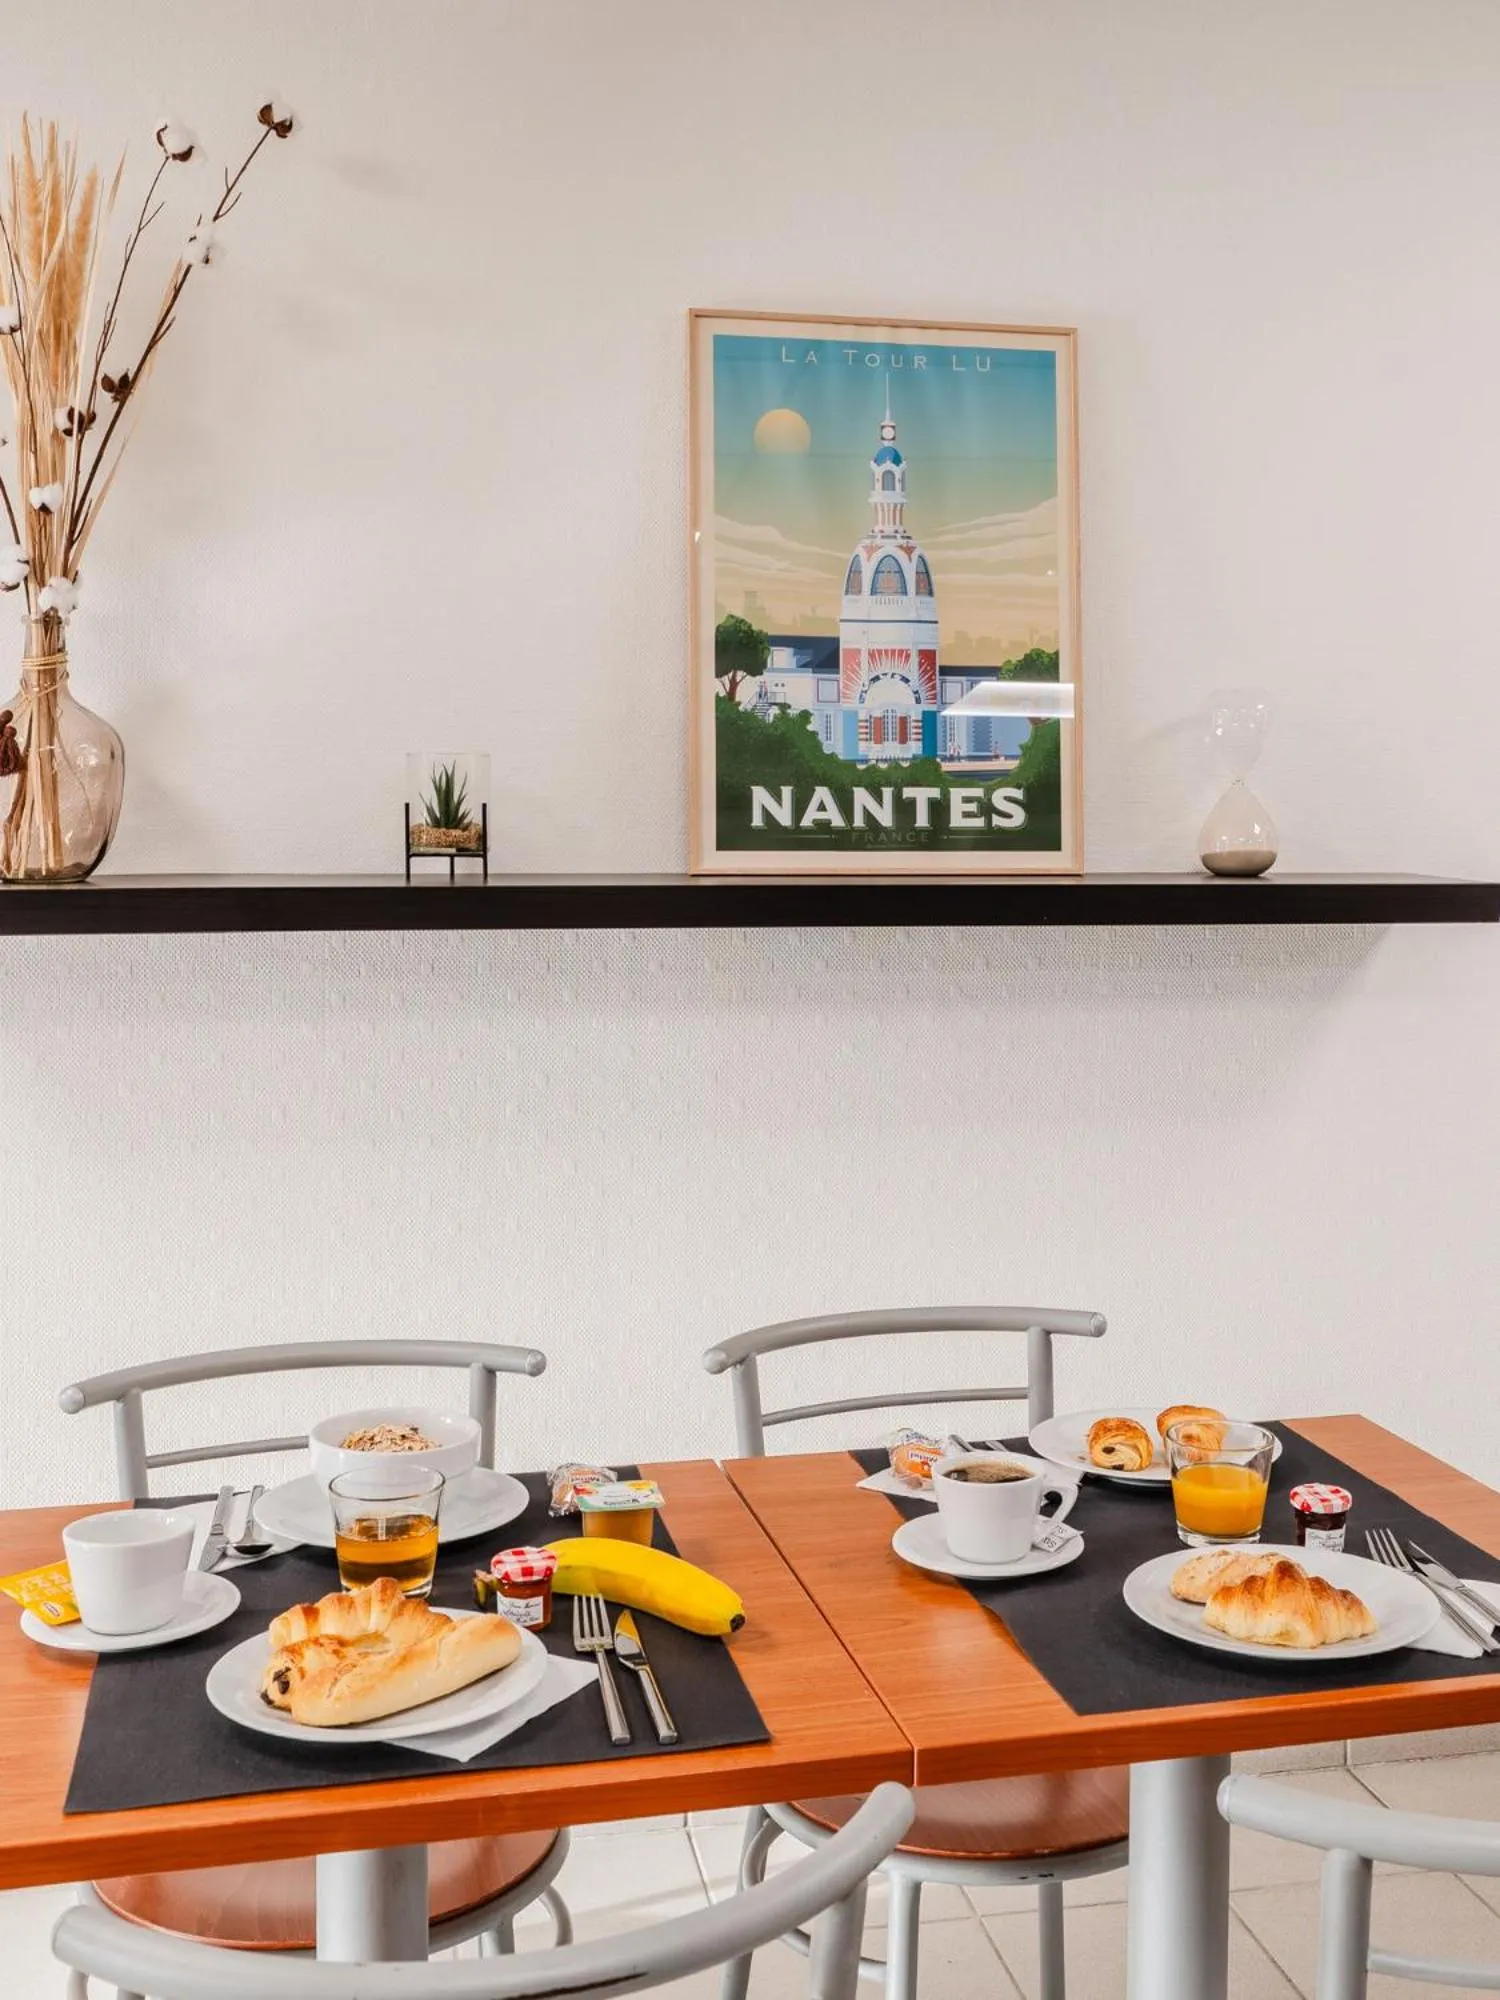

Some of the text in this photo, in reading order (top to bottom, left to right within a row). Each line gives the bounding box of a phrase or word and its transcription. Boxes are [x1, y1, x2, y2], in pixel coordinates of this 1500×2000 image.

[844, 349, 928, 370] TOUR
[952, 354, 991, 372] LU
[750, 785, 1027, 830] NANTES
[851, 830, 929, 843] FRANCE
